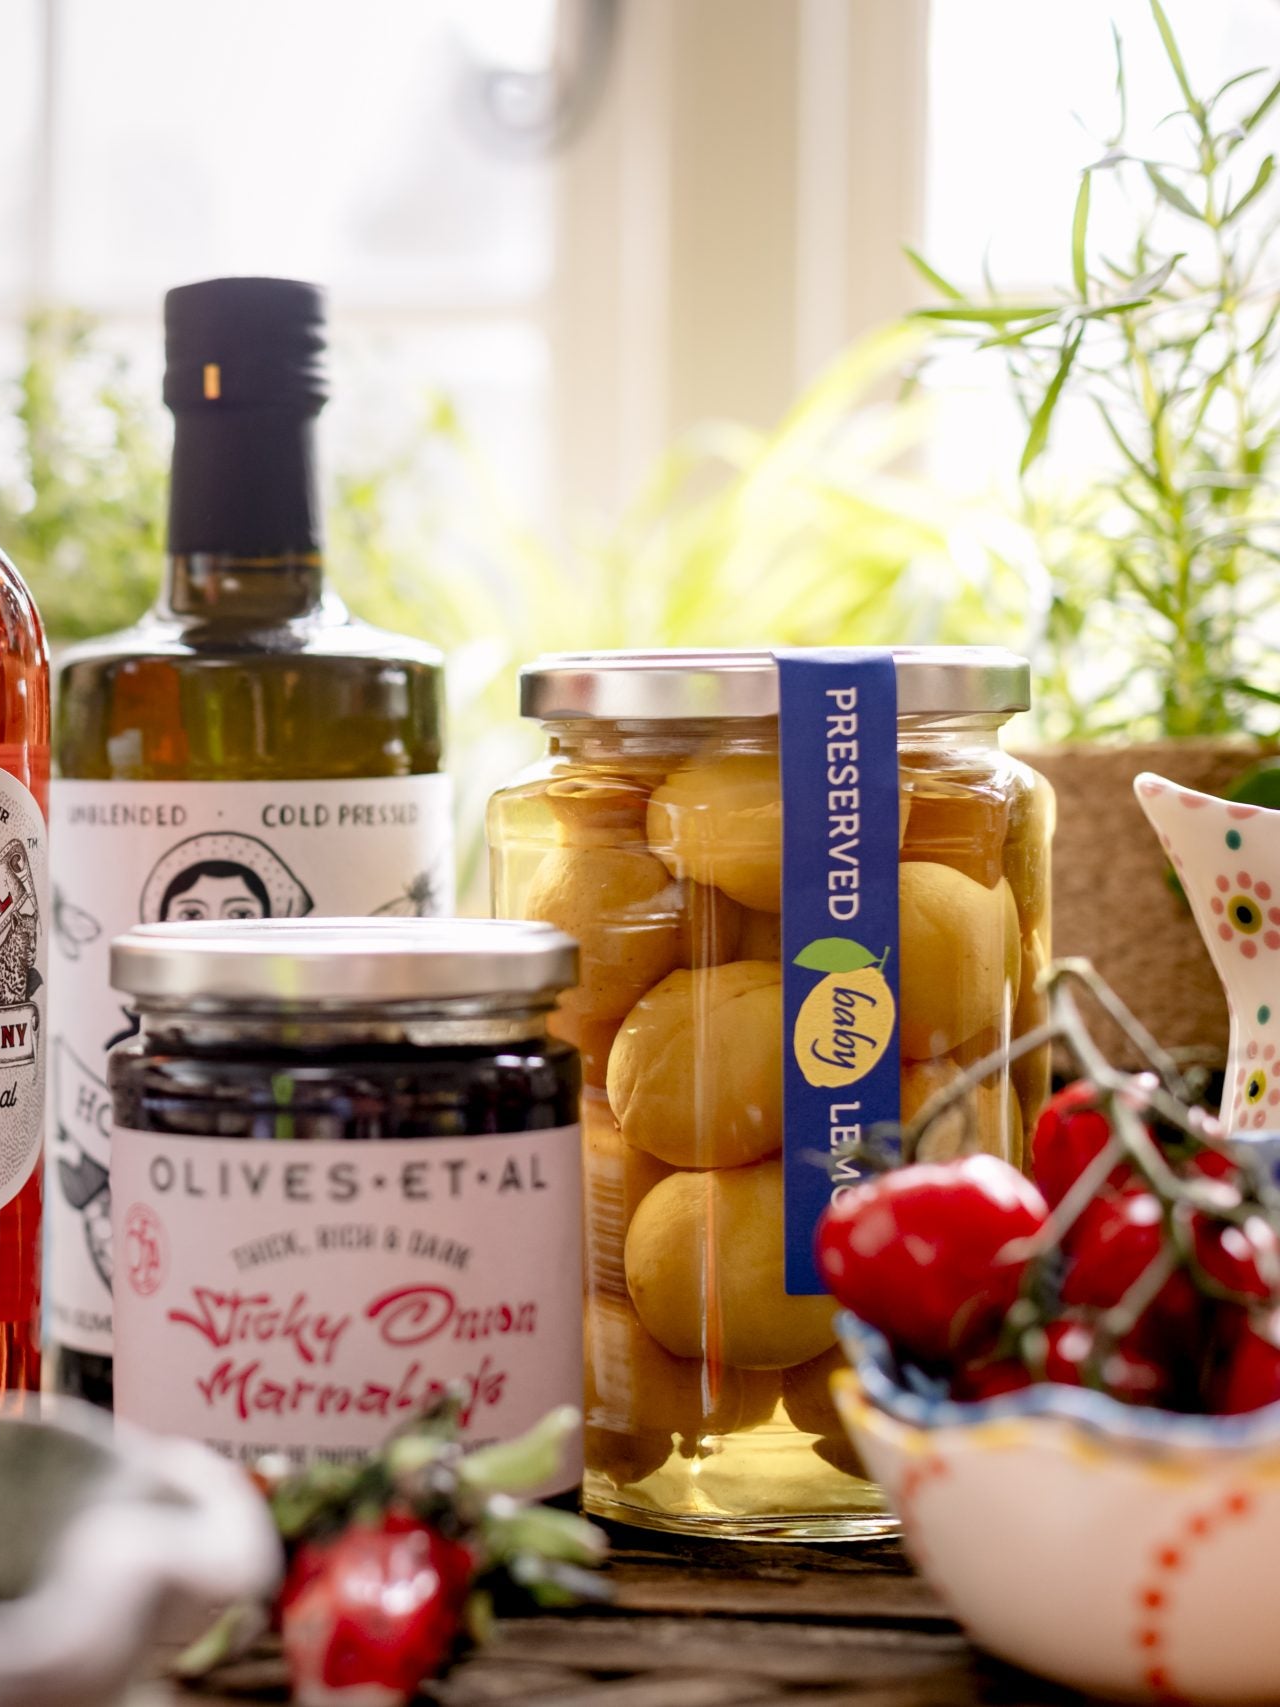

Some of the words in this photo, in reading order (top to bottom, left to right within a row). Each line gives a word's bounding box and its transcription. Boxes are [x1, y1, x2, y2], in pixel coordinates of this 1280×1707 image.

[261, 804, 329, 828] COLD
[338, 803, 419, 827] PRESSED
[825, 686, 862, 922] PRESERVED
[811, 986, 877, 1069] baby
[167, 1286, 351, 1364] Sticky
[365, 1282, 537, 1347] Onion
